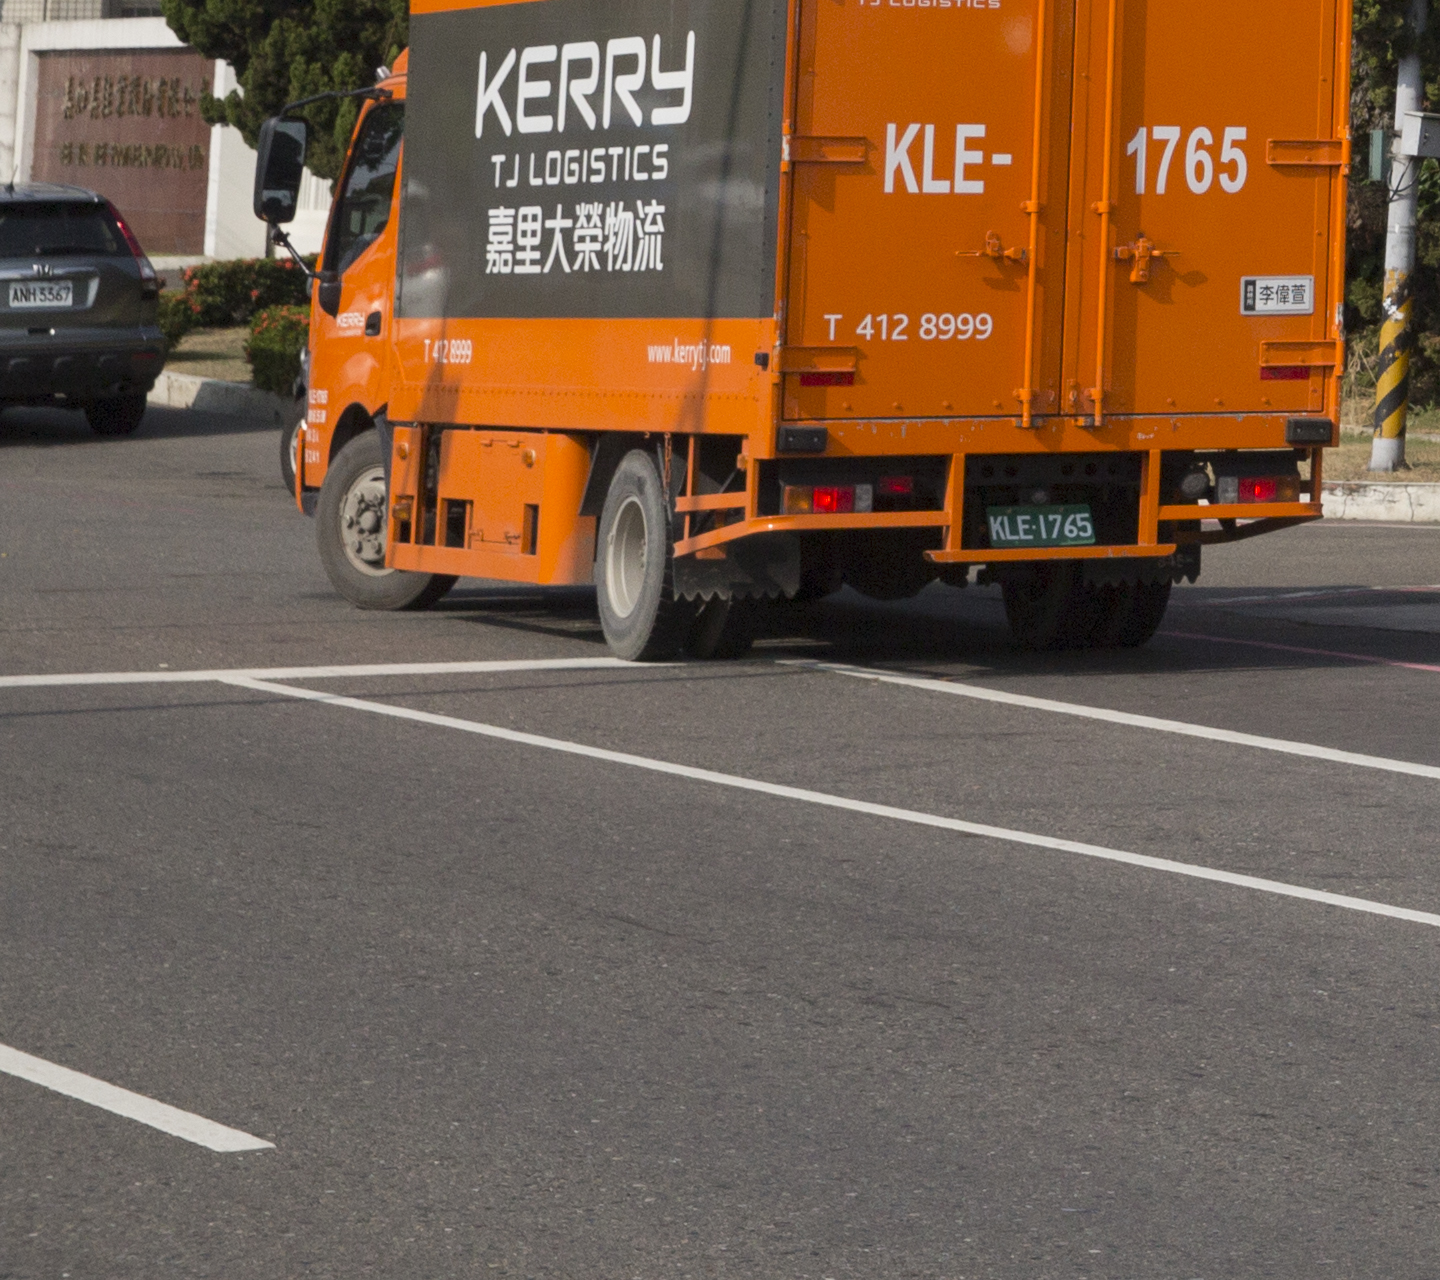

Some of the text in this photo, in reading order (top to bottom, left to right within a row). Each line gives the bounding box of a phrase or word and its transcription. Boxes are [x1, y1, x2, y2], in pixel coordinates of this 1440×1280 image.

[475, 30, 696, 139] KERRY
[491, 144, 669, 188] TJ LOGISTICS
[1126, 126, 1248, 196] 1765
[485, 199, 666, 274] 嘉里大榮物流
[1259, 284, 1306, 306] 李偉萱
[336, 312, 366, 328] KERRY
[824, 312, 993, 342] T 412 8999
[424, 340, 472, 364] T 412 8999
[647, 337, 731, 372] www.kerrytj.com
